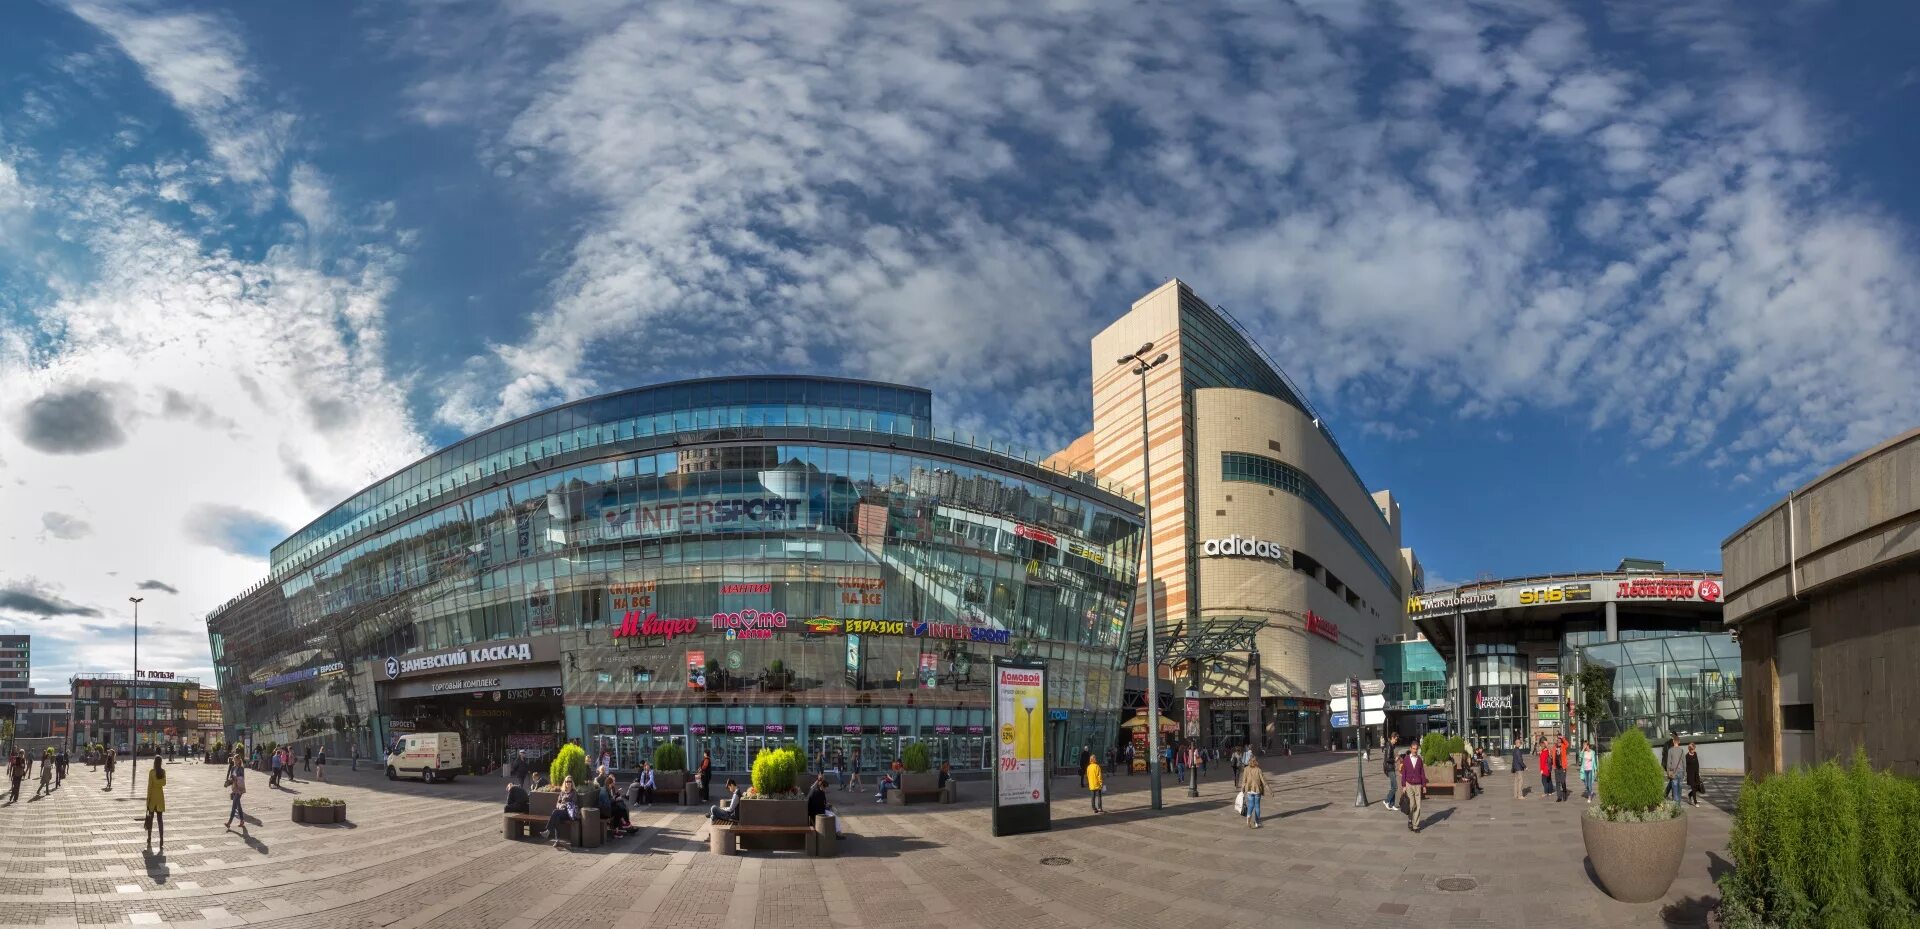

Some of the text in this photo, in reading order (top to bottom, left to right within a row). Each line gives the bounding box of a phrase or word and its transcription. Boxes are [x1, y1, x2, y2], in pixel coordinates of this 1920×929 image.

[635, 499, 801, 530] INTERSPORT
[1203, 534, 1282, 559] adidas
[1616, 582, 1695, 599] Леонардо
[613, 595, 650, 609] НА ВСЕ
[841, 593, 882, 605] НА ВСЕ
[1424, 592, 1495, 610] Макдоналдс
[613, 610, 698, 640] М.видео
[845, 619, 905, 635] ЕВРАЗИЯ
[737, 628, 773, 640] ДЕТЯМ
[928, 622, 1011, 645] INTERSPORT
[400, 643, 532, 673] ЗАНЕВСКИЙ КАСКАД
[148, 670, 175, 679] ПОЛЬЗА
[431, 678, 498, 692] ТОРГОВЫЙ КОМПЛЕКС
[1481, 701, 1512, 709] КАСКАД
